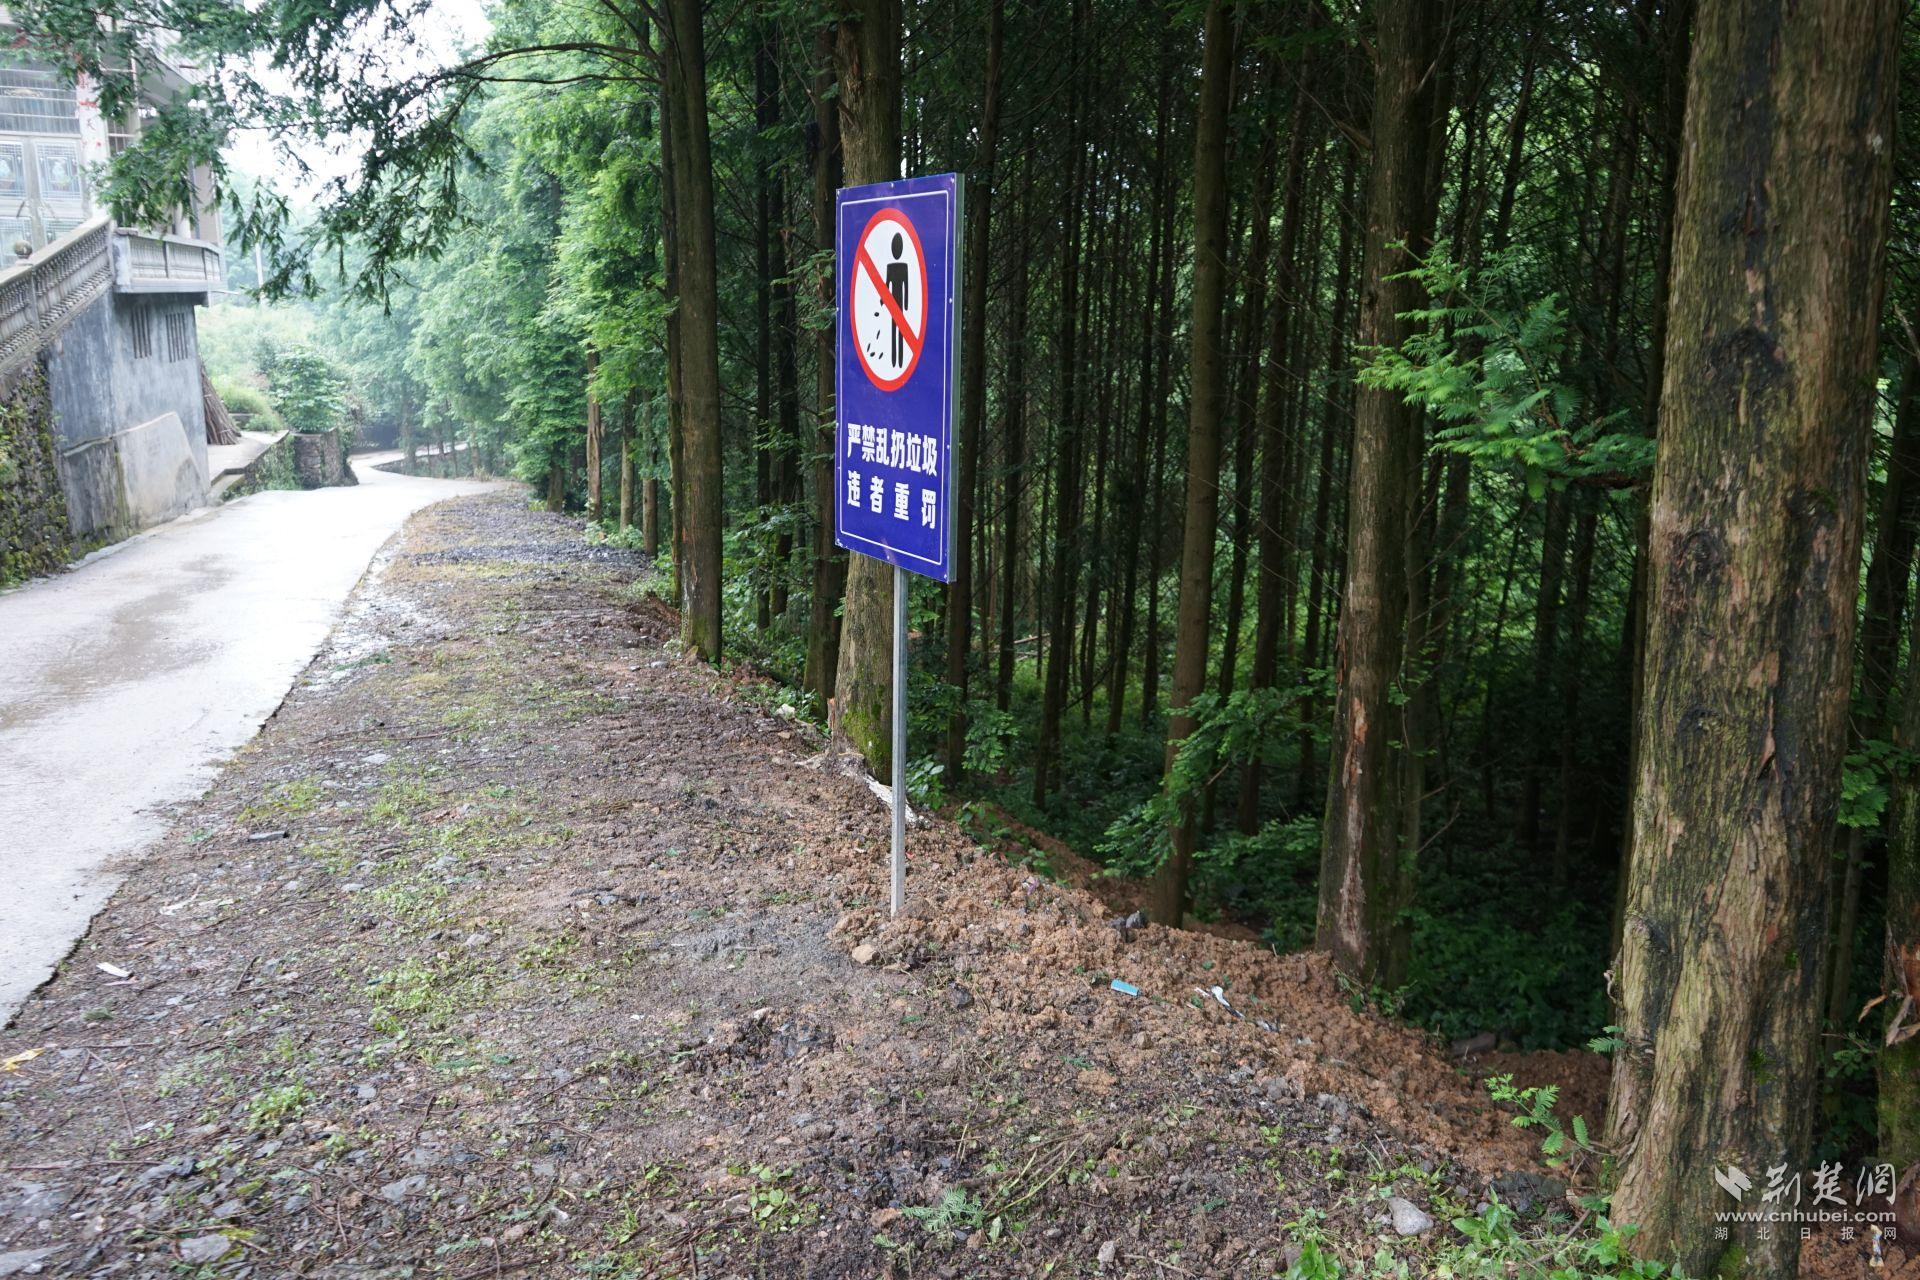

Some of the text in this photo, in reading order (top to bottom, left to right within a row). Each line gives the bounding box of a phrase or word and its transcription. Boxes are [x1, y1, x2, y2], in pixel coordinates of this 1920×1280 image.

[847, 423, 938, 476] 严禁乱扔垃圾
[847, 470, 937, 529] 违者重罚
